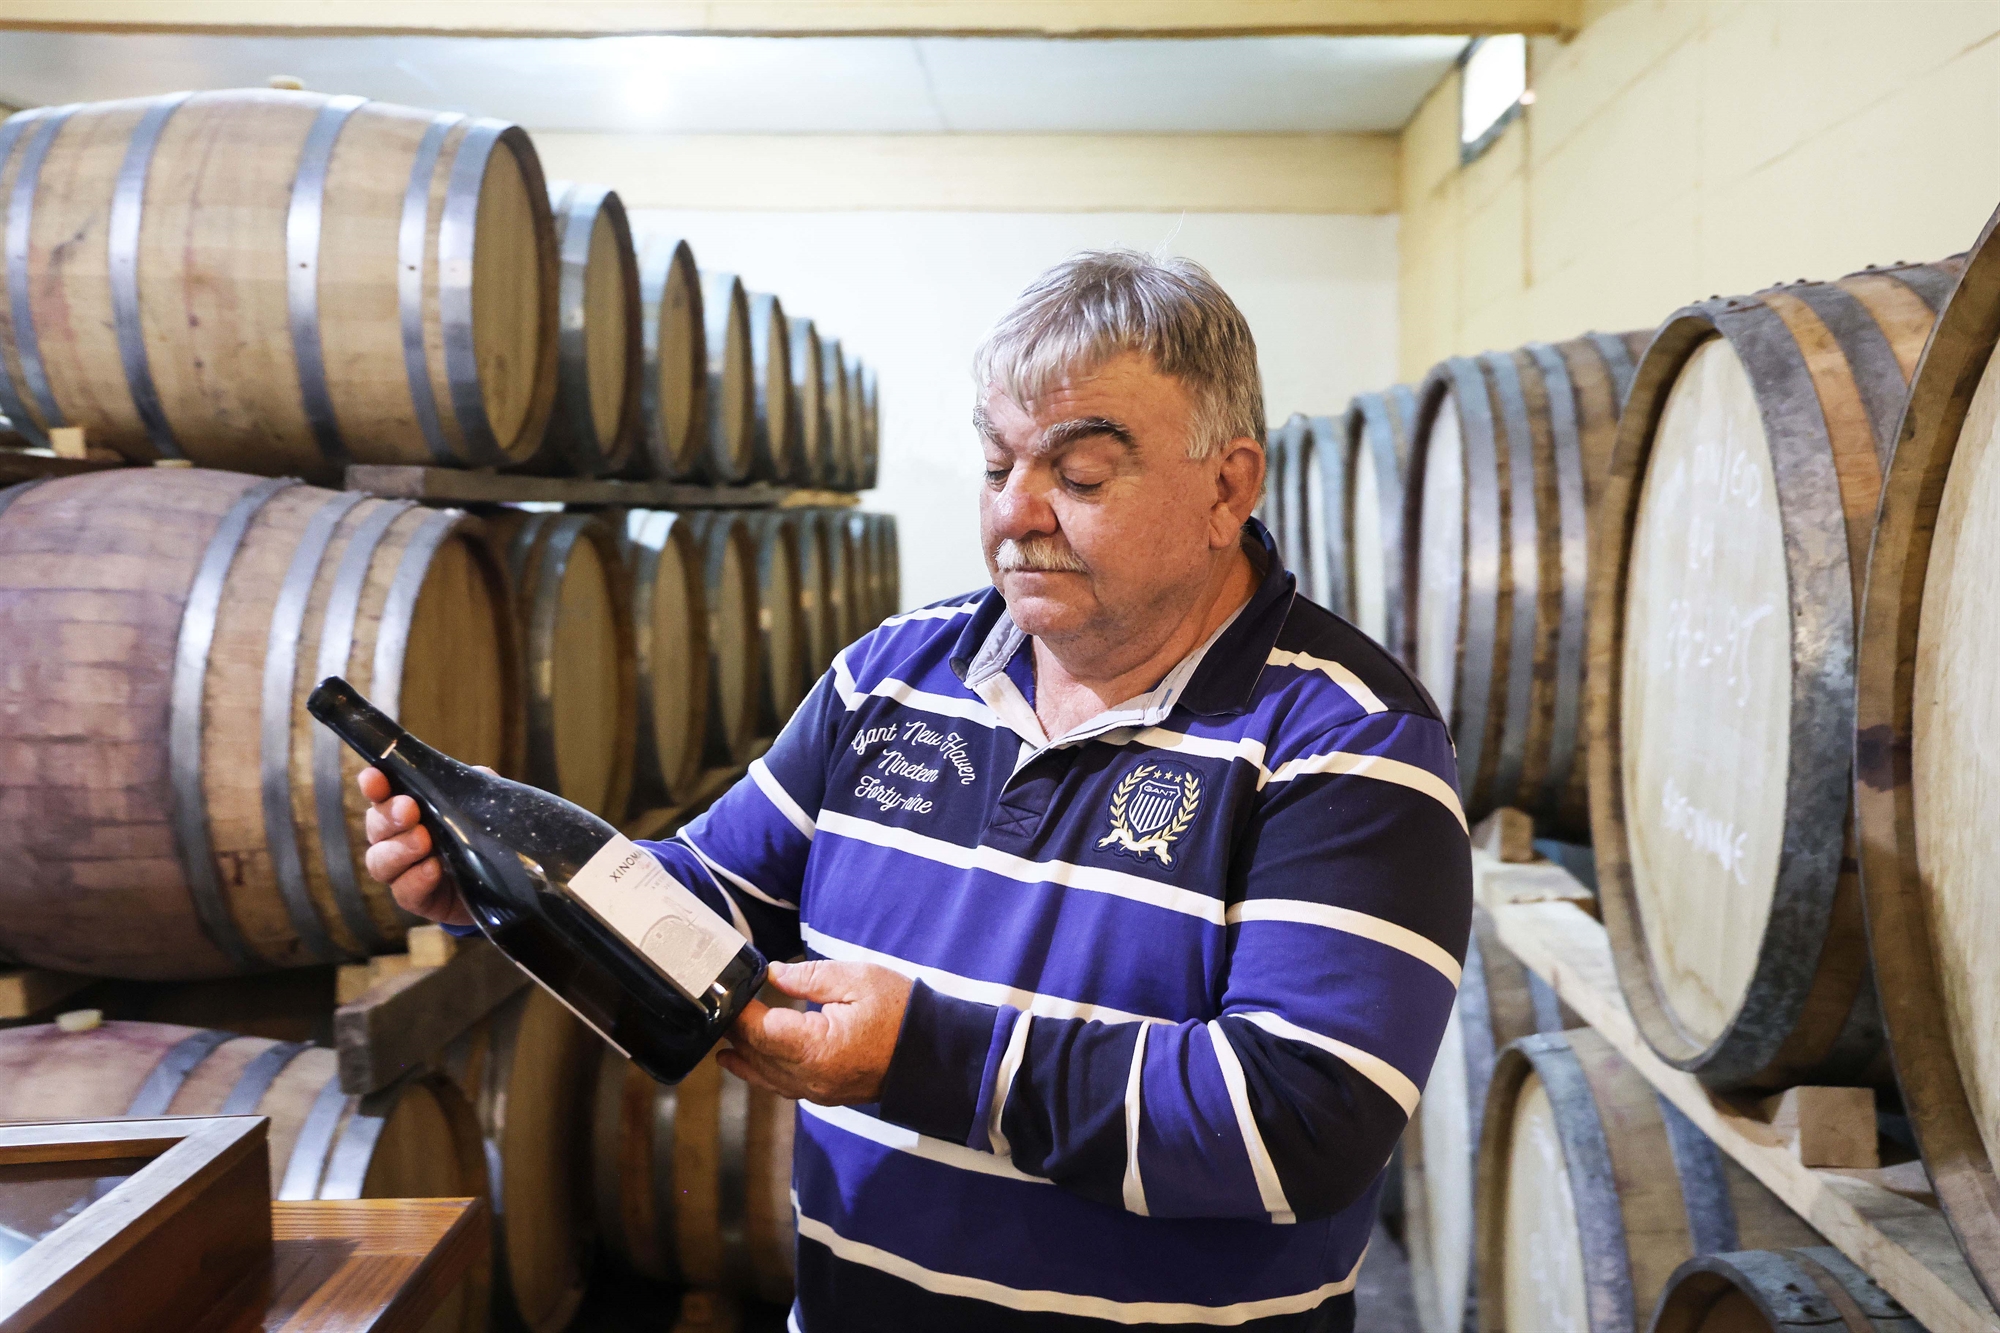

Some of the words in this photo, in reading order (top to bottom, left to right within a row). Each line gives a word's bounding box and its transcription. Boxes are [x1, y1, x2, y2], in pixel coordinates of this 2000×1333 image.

[851, 723, 898, 755] Gant
[903, 721, 944, 746] New
[940, 732, 976, 785] Haven
[878, 749, 939, 782] Nineteen
[855, 775, 933, 814] Forty-nine
[1144, 785, 1176, 797] GANT
